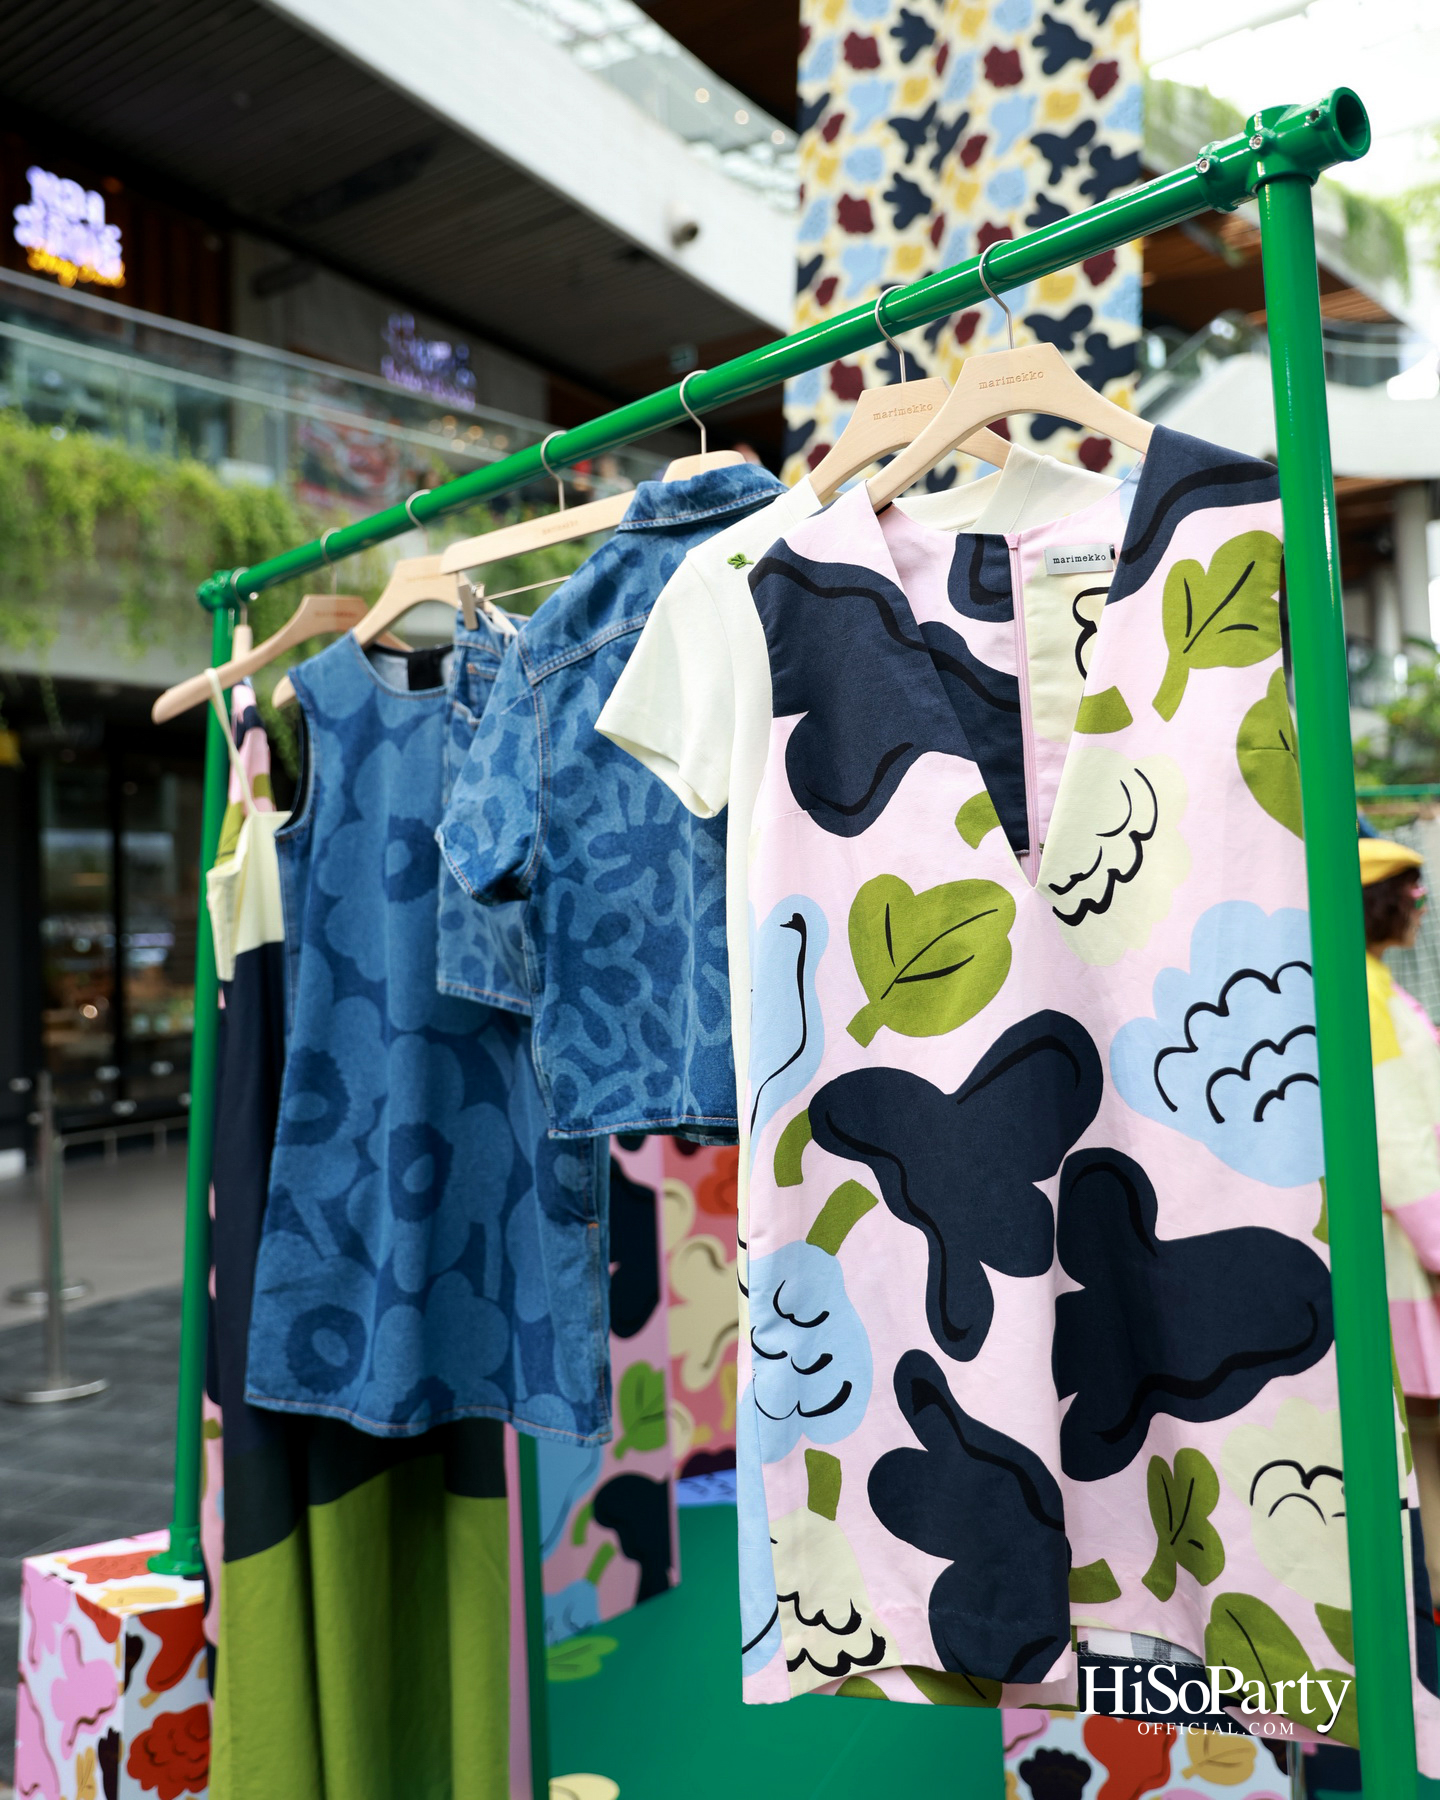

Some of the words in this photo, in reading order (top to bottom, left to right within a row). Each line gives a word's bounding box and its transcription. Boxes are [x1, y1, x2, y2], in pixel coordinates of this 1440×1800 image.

[978, 370, 1044, 389] marimekko
[873, 402, 933, 421] marimekko
[1052, 553, 1107, 565] marimekko
